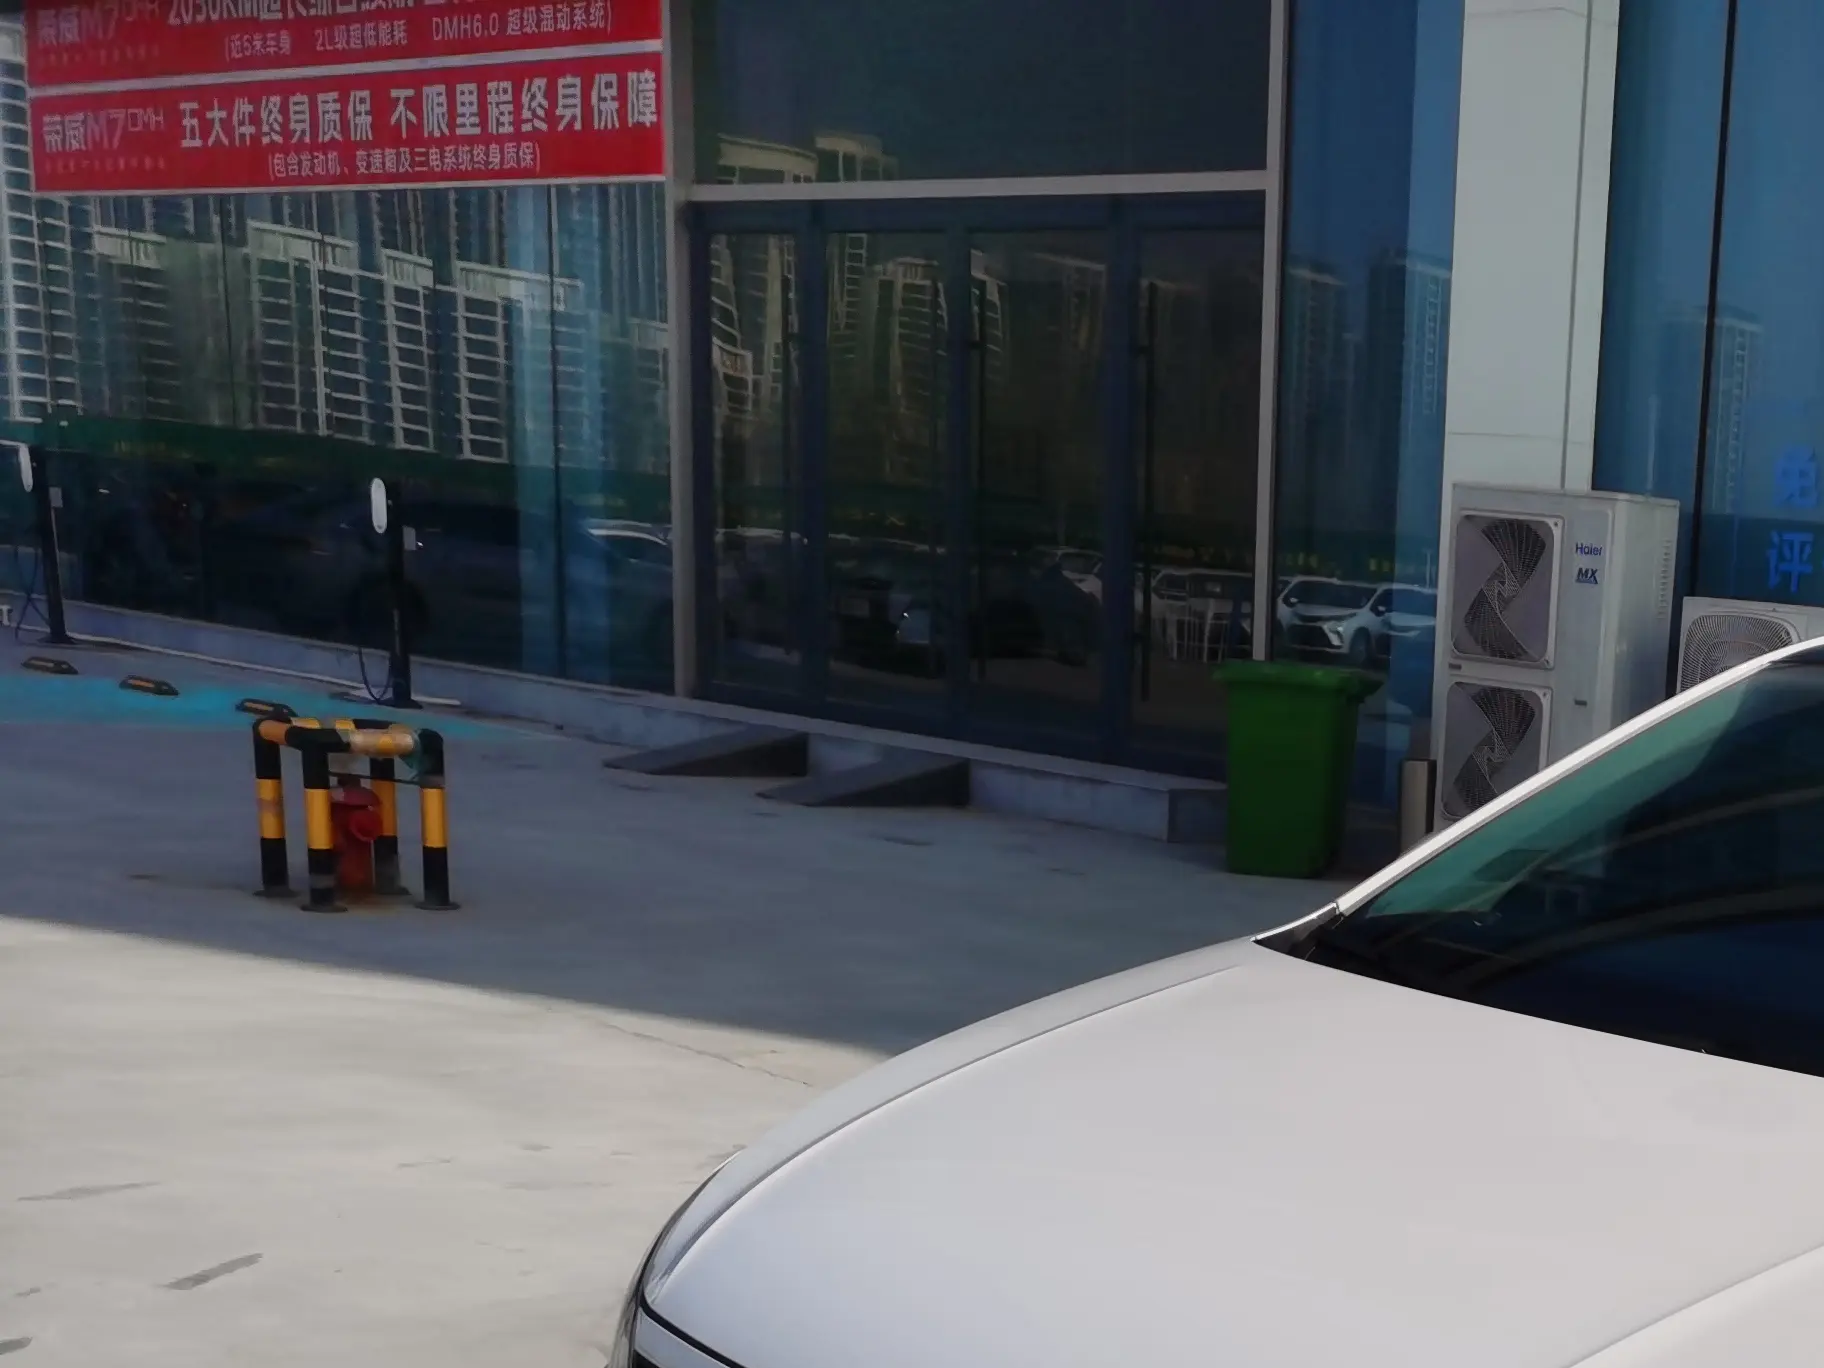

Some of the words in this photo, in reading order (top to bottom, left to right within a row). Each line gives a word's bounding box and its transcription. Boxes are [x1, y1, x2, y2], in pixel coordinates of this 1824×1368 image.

[432, 12, 499, 41] DMH6.0
[180, 87, 374, 149] 五大件终身质保
[390, 68, 659, 140] 不限里程终身保障
[1575, 541, 1603, 556] Haier
